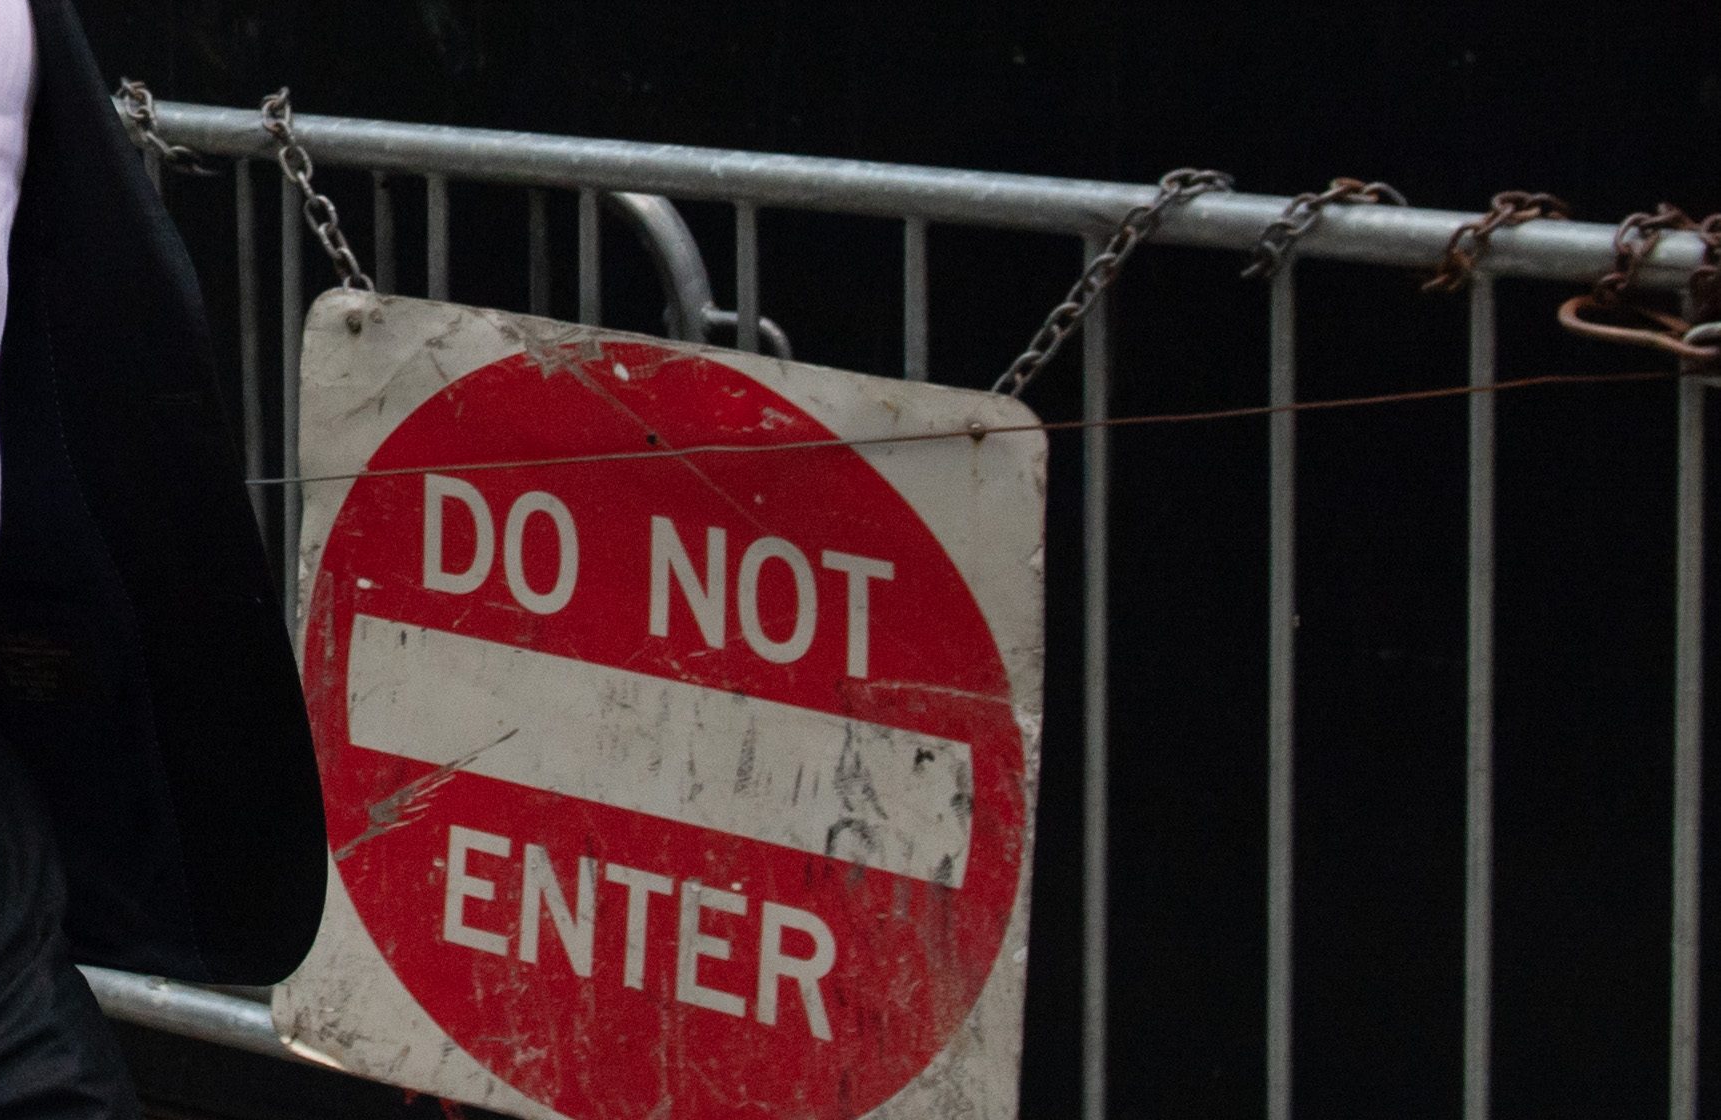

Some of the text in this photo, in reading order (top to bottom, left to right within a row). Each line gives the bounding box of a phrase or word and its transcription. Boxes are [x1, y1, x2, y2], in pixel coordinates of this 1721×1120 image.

[422, 474, 895, 680] DO NOT
[442, 824, 838, 1042] ENTER
